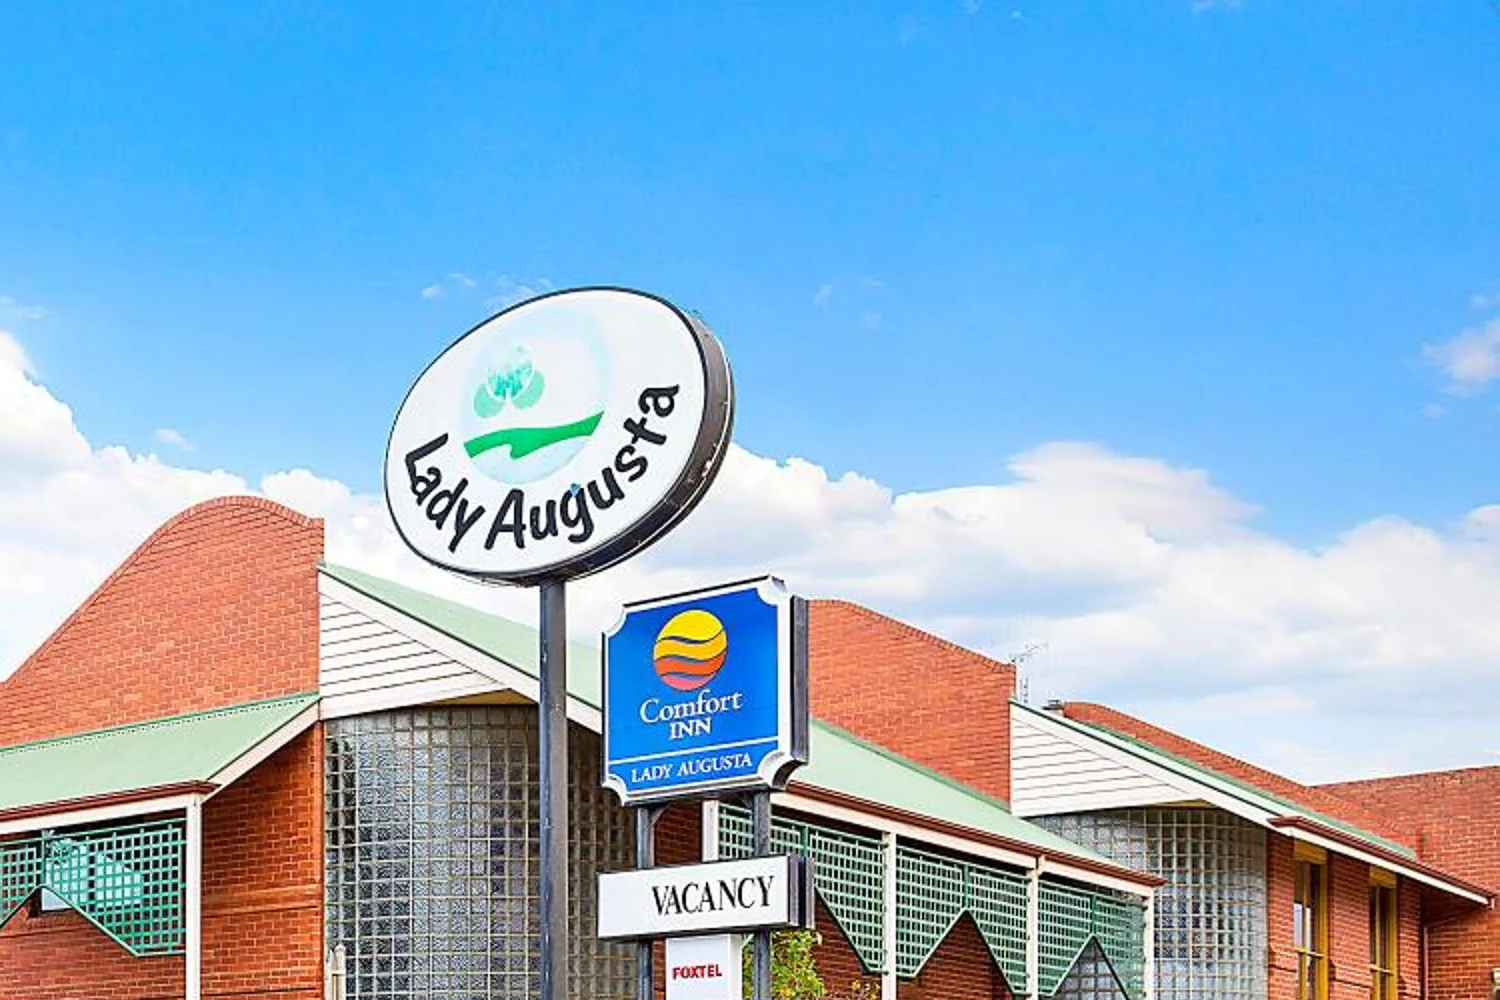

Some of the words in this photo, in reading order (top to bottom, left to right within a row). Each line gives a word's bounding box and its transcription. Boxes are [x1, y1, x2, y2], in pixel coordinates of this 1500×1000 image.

[405, 432, 487, 553] Lady
[483, 384, 681, 550] Augusta
[639, 689, 743, 723] Comfort
[669, 718, 712, 739] INN
[631, 763, 673, 783] LADY
[677, 752, 753, 776] AUGUSTA
[652, 875, 775, 916] VACANCY
[672, 963, 723, 981] FOXTEL
